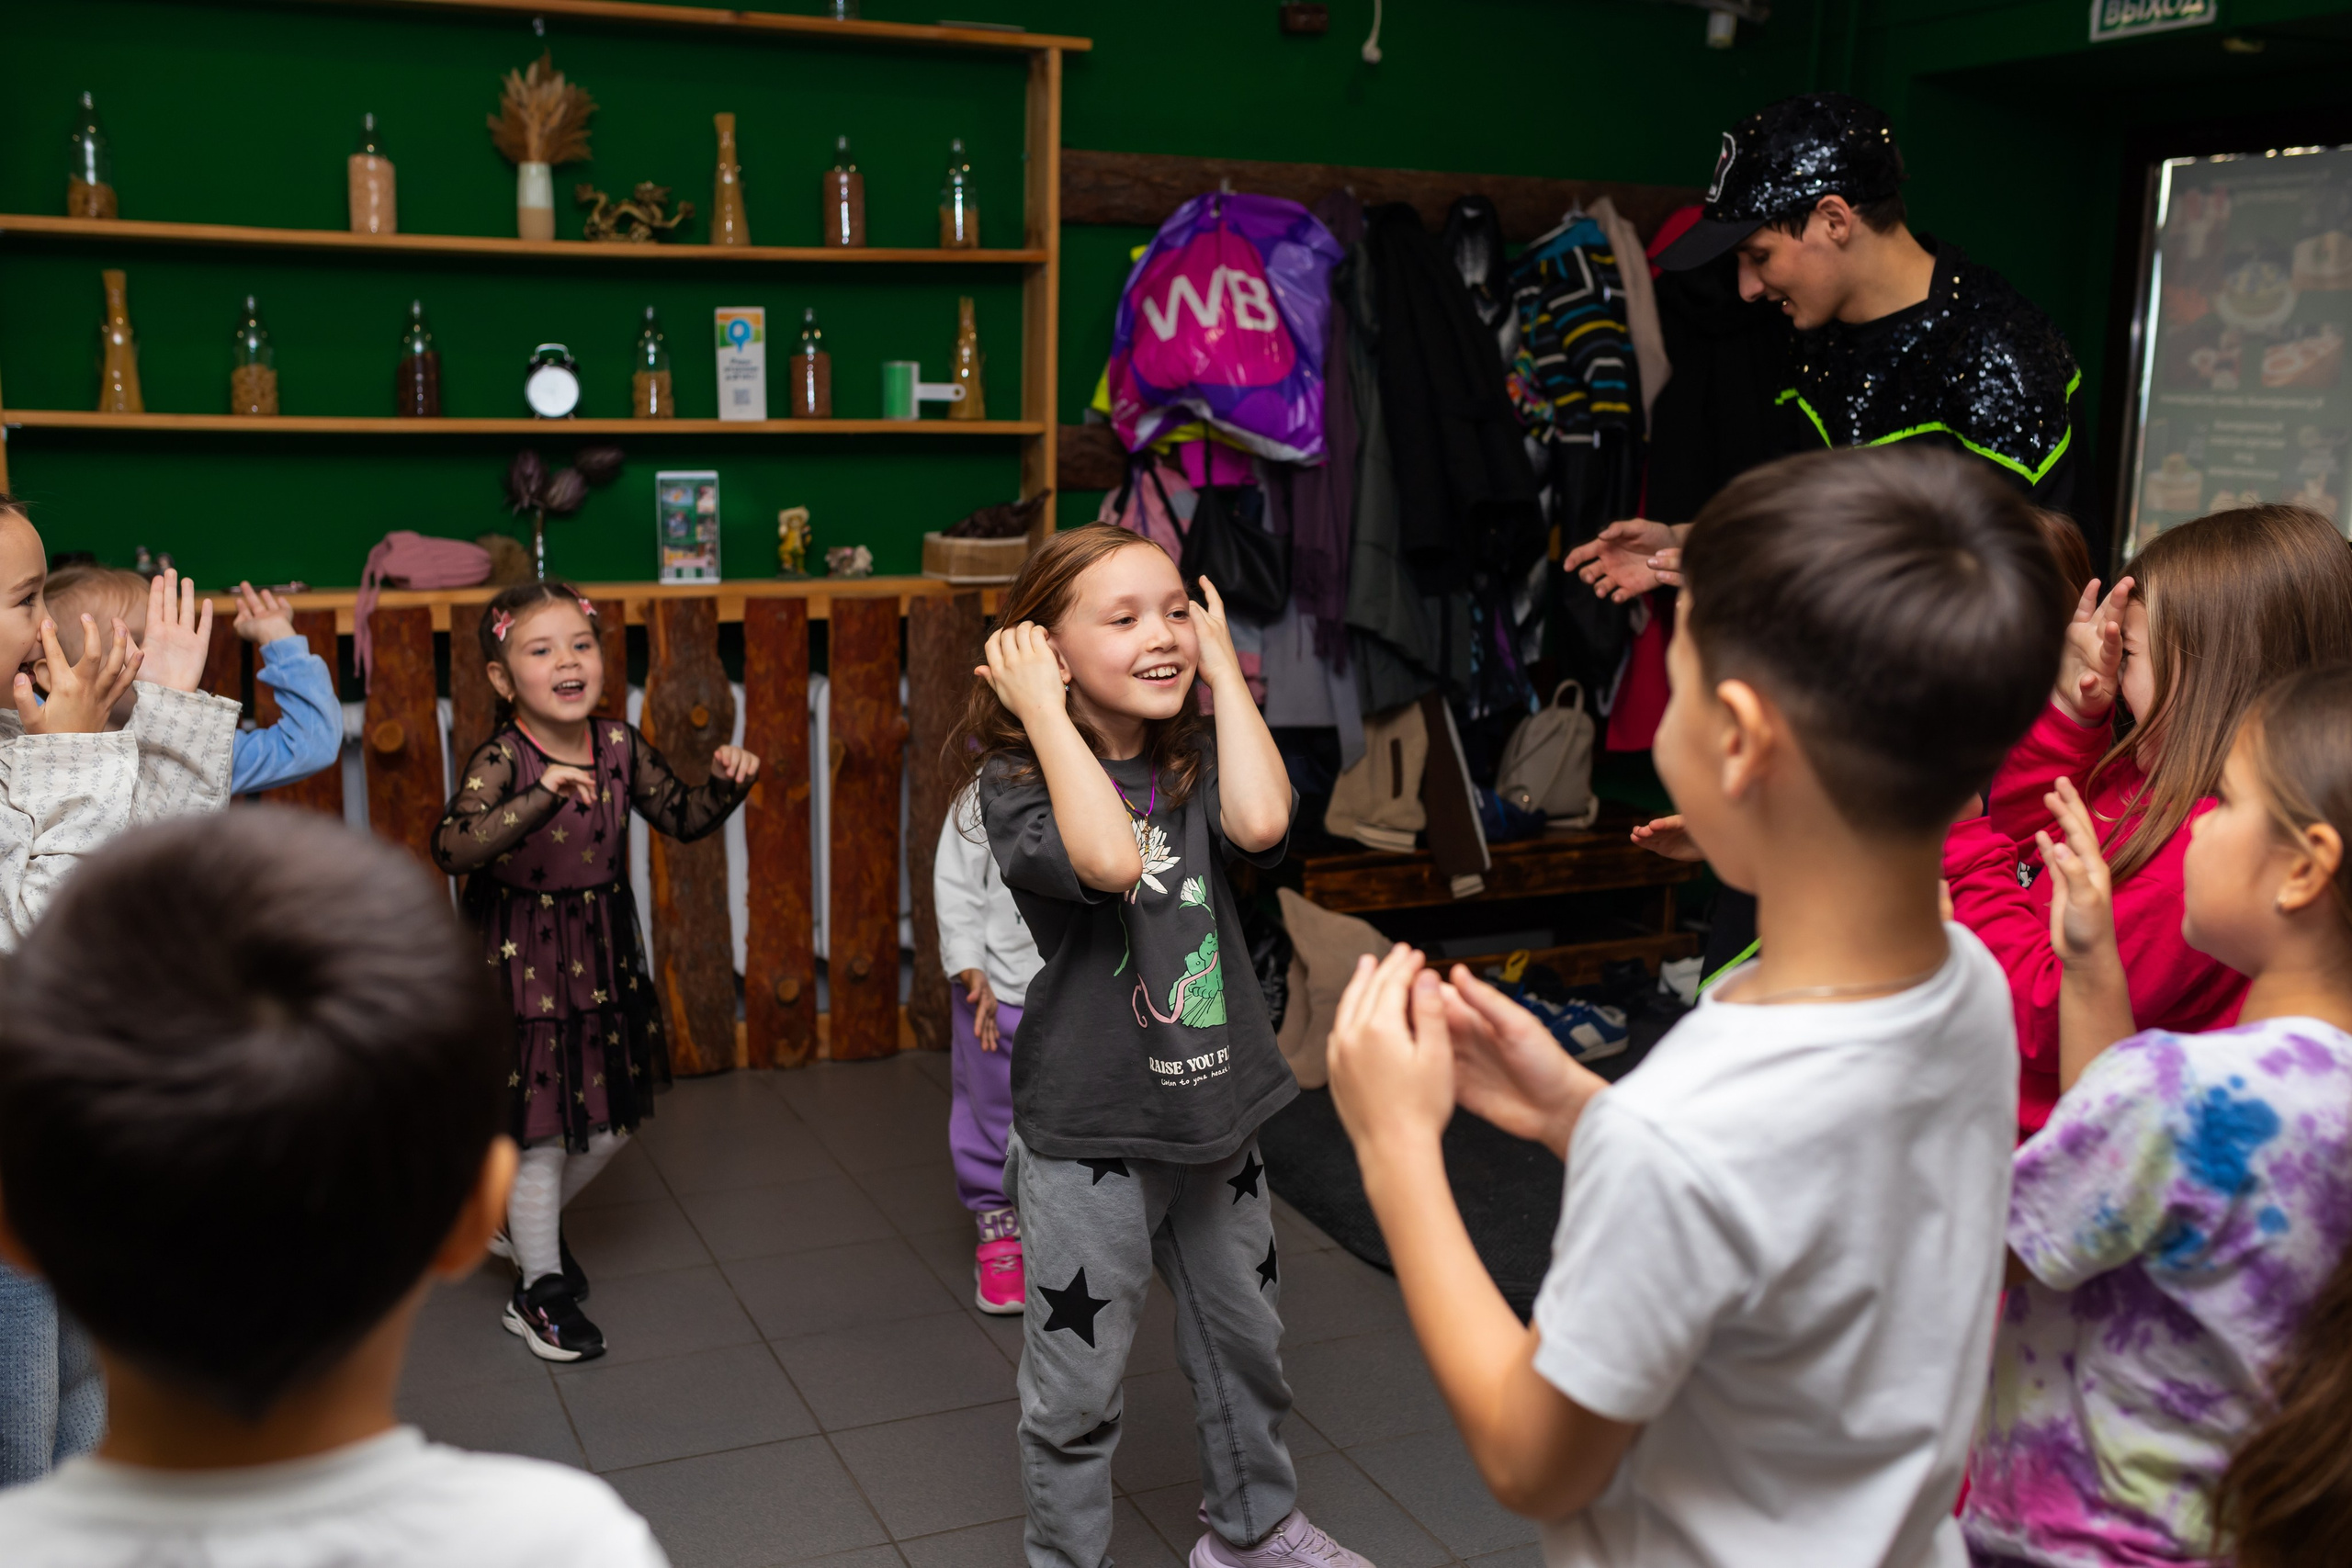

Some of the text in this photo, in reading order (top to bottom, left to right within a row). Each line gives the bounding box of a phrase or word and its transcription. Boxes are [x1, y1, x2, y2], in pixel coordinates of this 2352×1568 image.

[1142, 264, 1278, 342] WB
[1149, 1056, 1183, 1075] RAISE
[1187, 1053, 1214, 1072] YOU
